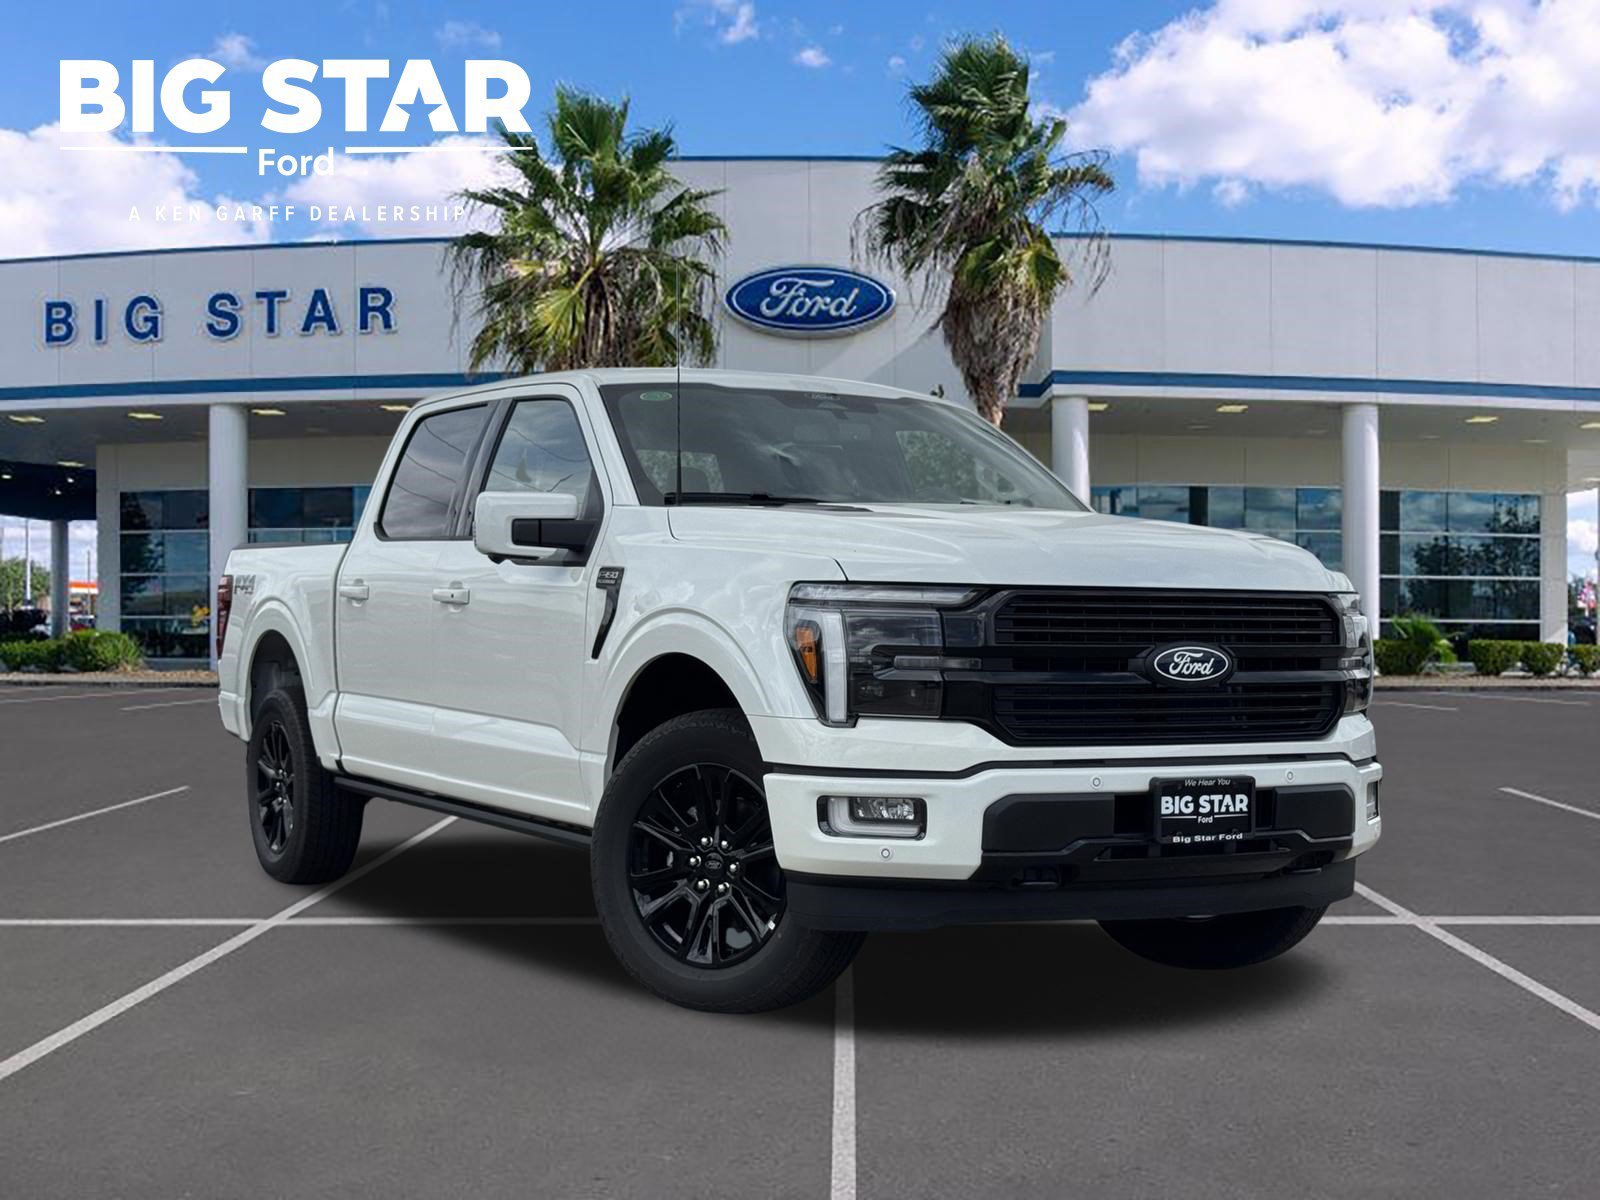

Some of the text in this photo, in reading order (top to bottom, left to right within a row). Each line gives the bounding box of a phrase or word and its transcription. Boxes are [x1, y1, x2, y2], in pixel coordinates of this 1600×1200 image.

[760, 277, 860, 318] Ford
[44, 286, 398, 346] BIG STAR
[1168, 651, 1215, 675] Ford
[1184, 778, 1231, 787] We Hear You
[1160, 794, 1249, 815] BIG STAR
[1197, 816, 1213, 824] Ford
[1172, 833, 1243, 844] Big Star Ford
